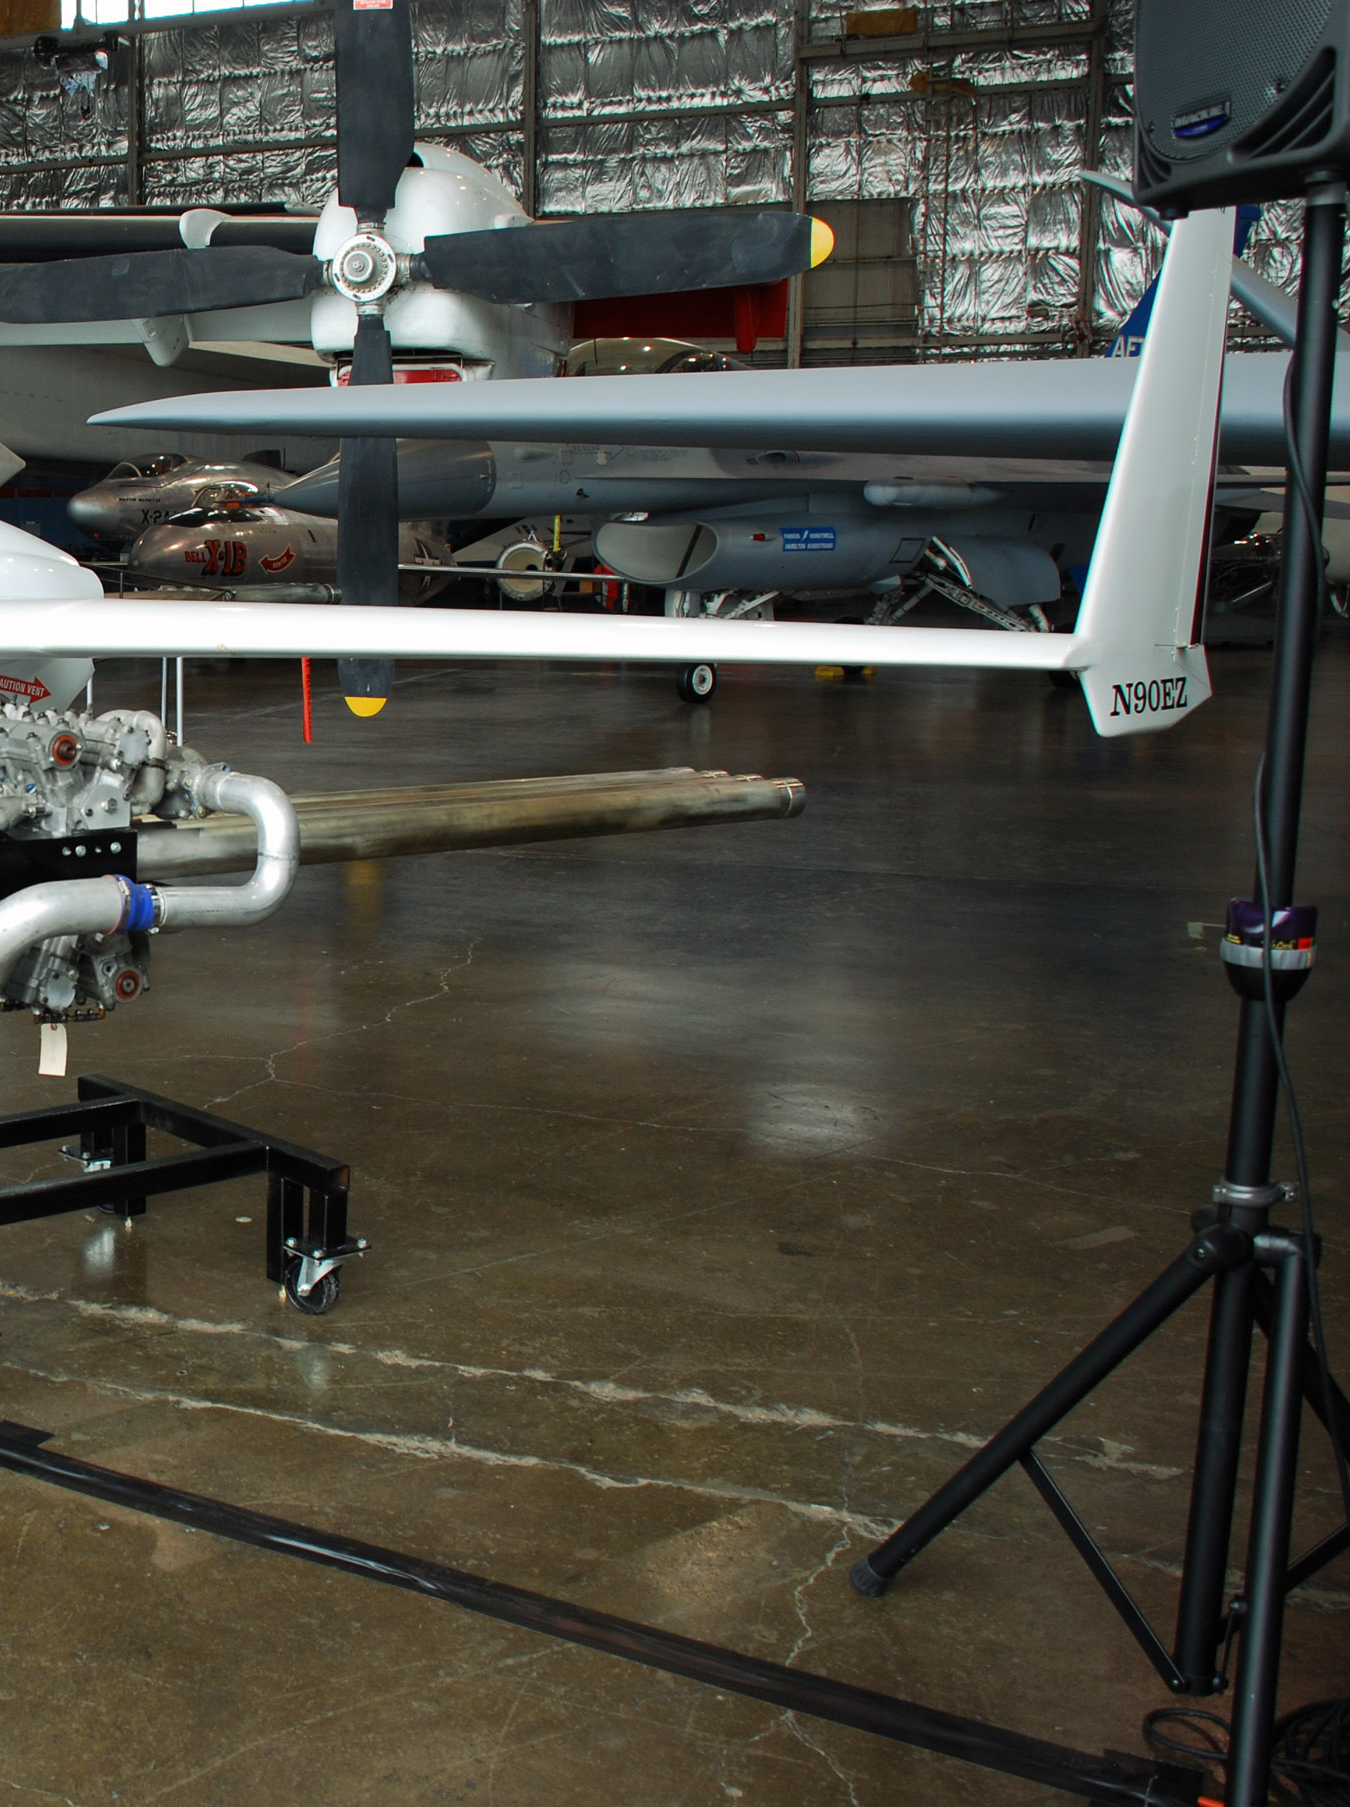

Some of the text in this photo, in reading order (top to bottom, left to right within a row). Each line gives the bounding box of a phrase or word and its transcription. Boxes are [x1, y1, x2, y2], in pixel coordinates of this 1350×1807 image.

[184, 550, 206, 563] BELL
[27, 684, 46, 697] VENT
[1109, 676, 1188, 717] N90EZ
